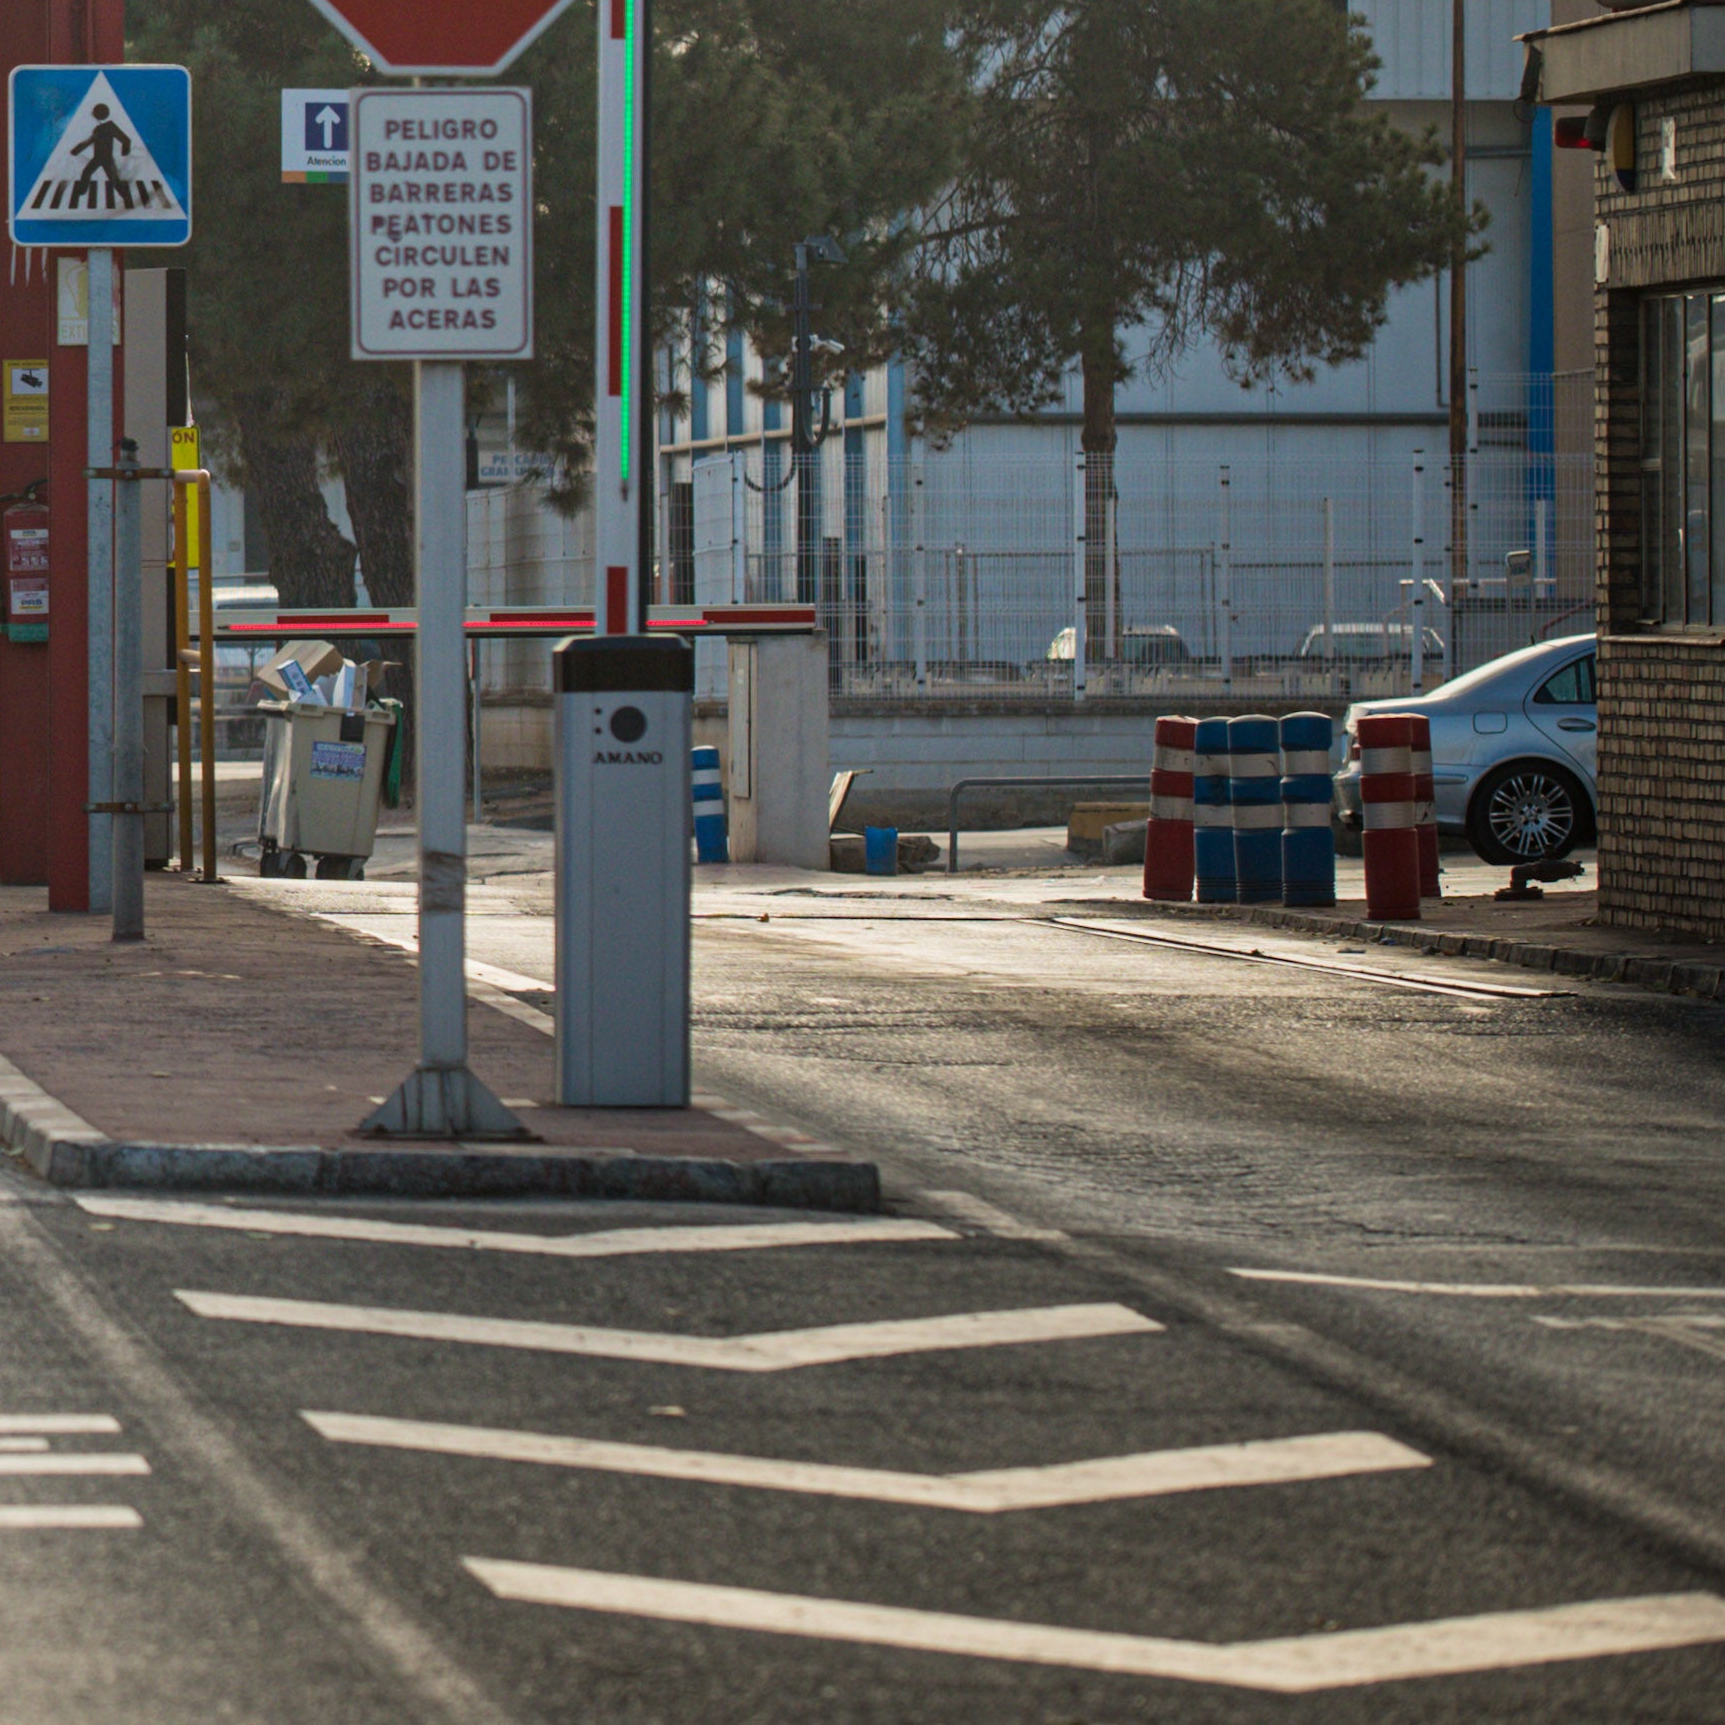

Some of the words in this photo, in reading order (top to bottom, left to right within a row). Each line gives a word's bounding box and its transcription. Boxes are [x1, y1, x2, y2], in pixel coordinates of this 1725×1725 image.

[384, 119, 498, 141] PELIGRO
[365, 151, 468, 172] BAJADA
[482, 150, 518, 172] DE
[369, 181, 513, 204] BARRERAS
[370, 213, 512, 235] PEATONES
[374, 245, 510, 267] CIRCULEN
[382, 277, 436, 299] POR
[451, 277, 502, 299] LAS
[388, 309, 497, 330] ACERAS
[171, 429, 196, 445] ÓN
[592, 749, 664, 765] AMANO
